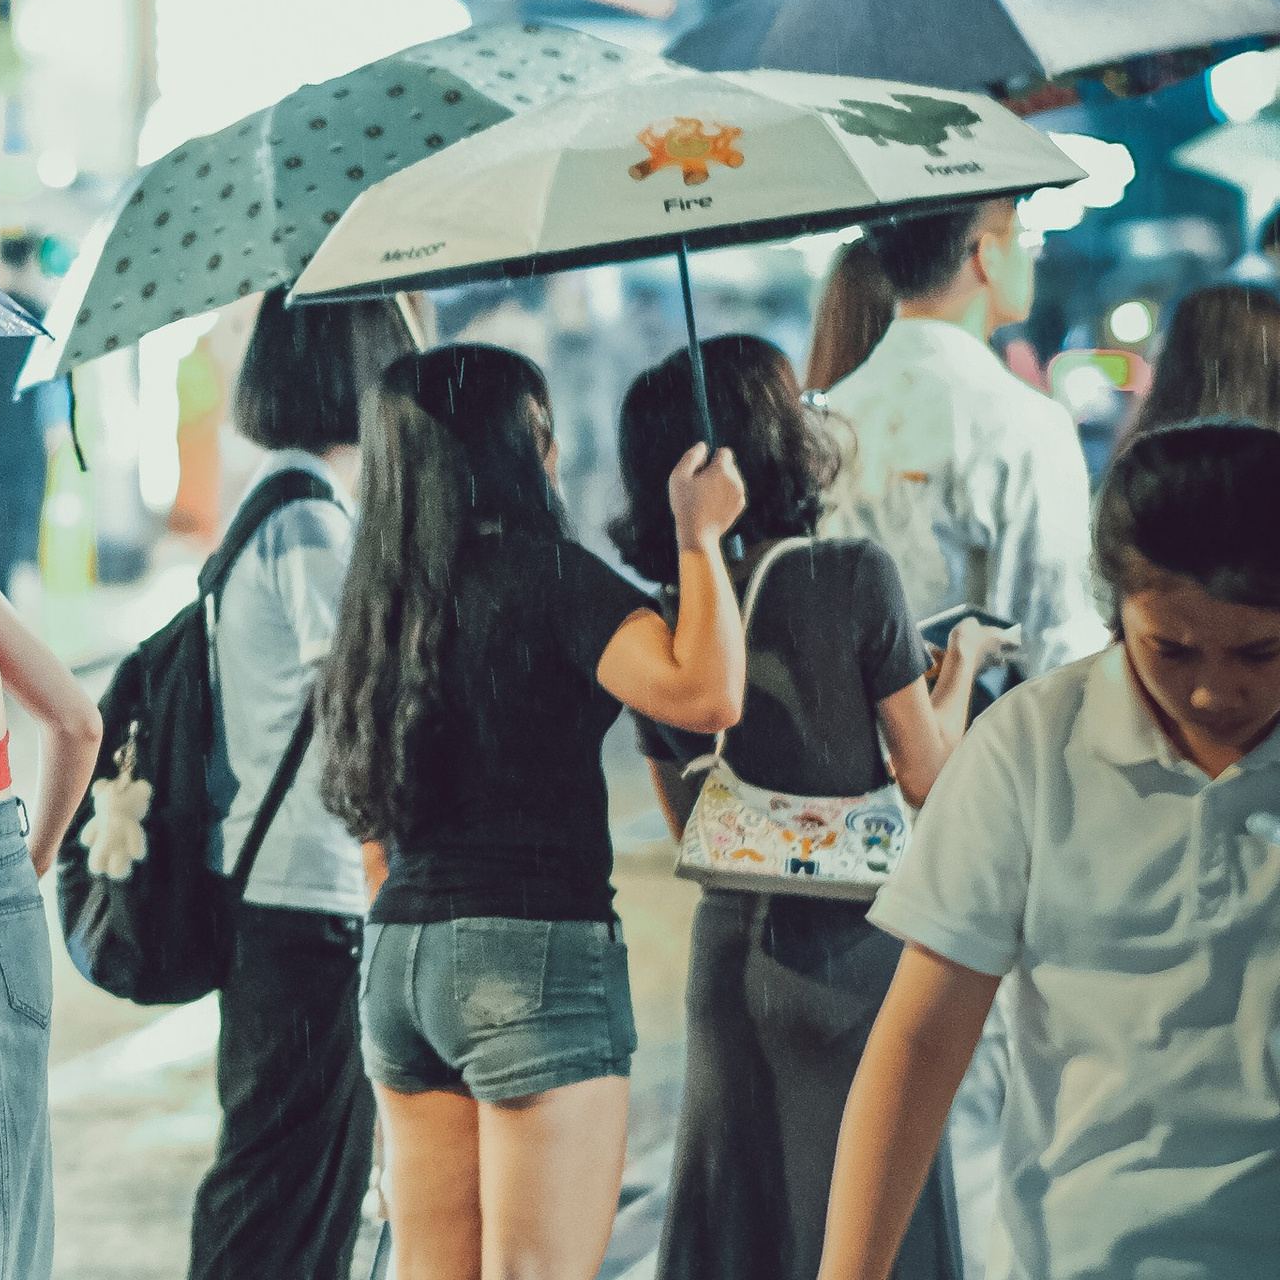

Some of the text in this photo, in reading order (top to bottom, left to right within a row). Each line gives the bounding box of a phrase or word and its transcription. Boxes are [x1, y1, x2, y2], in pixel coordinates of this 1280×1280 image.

[924, 161, 984, 176] Forest
[663, 197, 713, 213] Fire
[380, 241, 446, 262] Meteor
